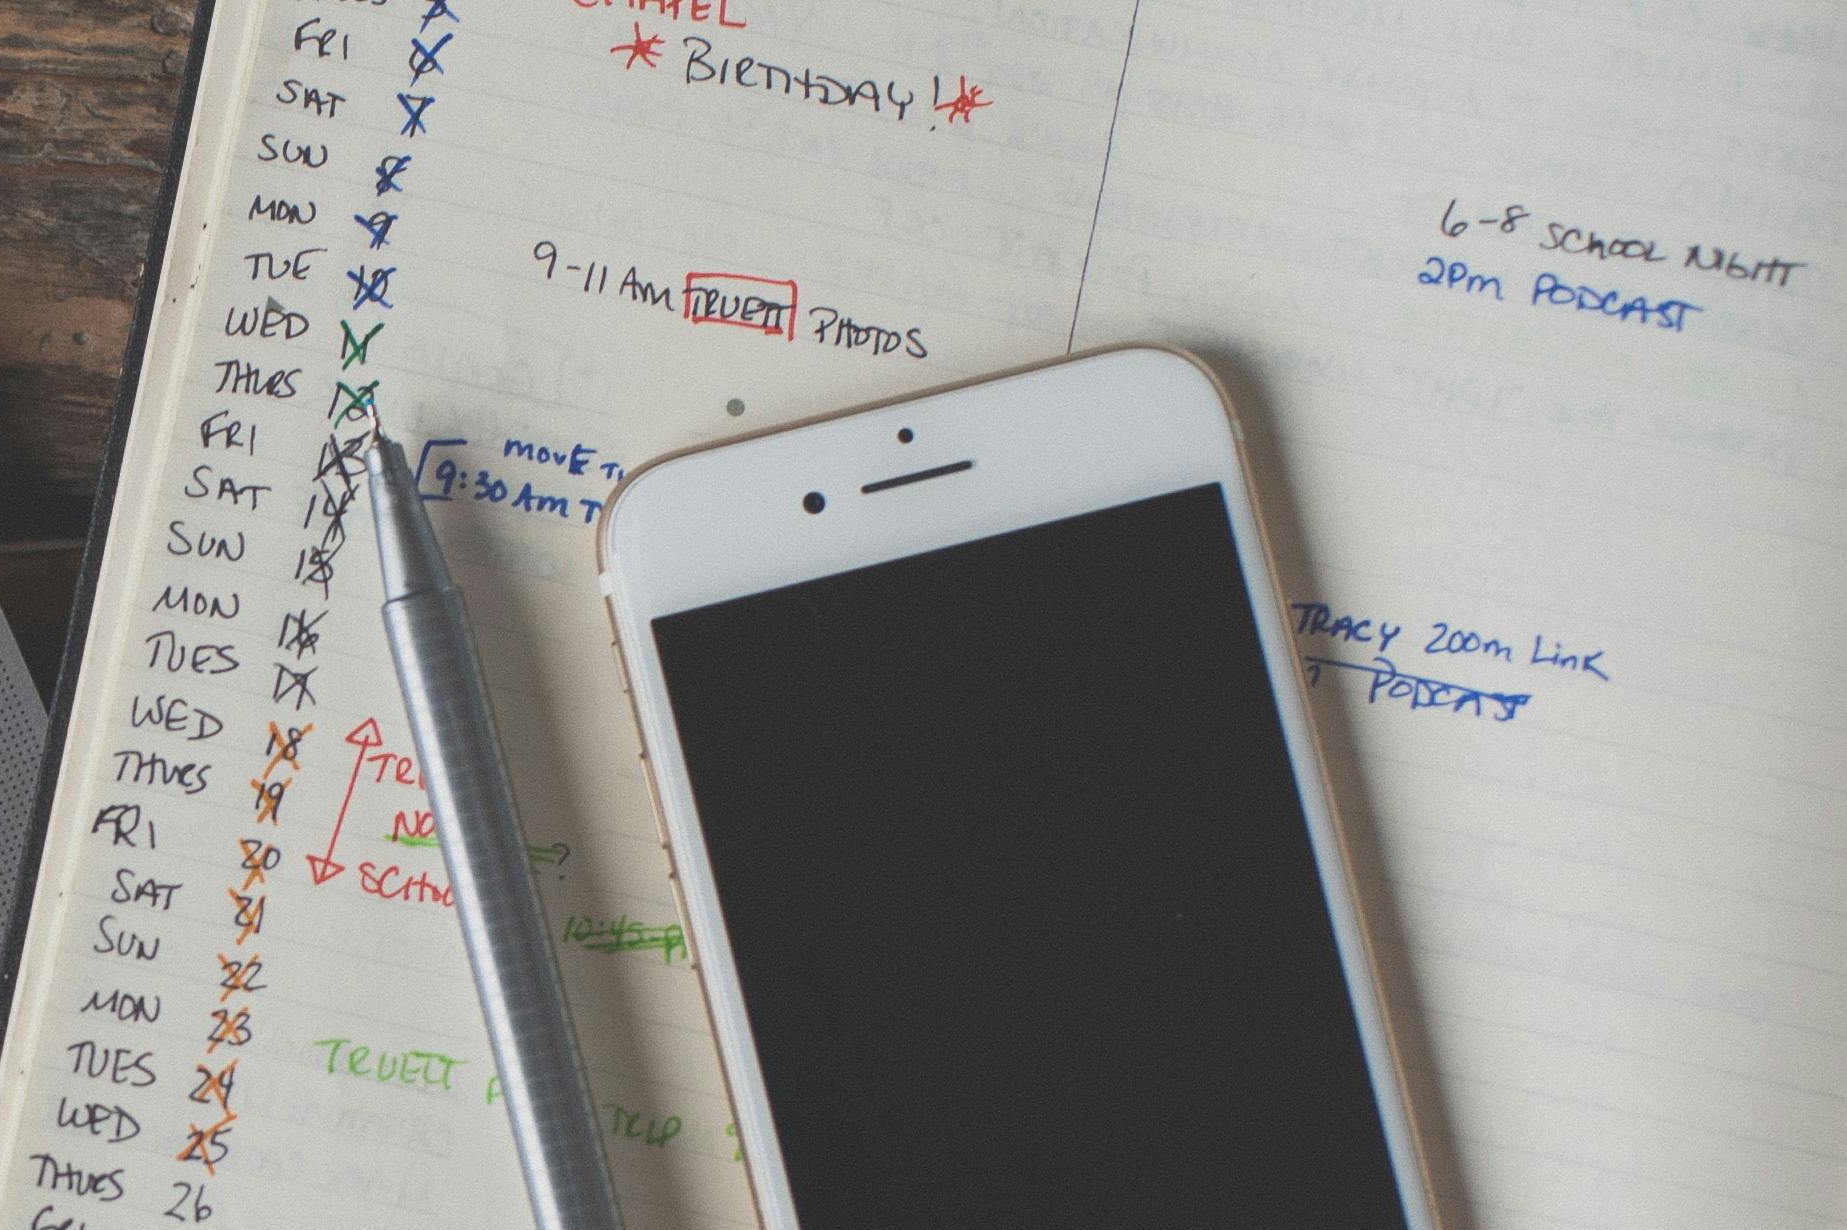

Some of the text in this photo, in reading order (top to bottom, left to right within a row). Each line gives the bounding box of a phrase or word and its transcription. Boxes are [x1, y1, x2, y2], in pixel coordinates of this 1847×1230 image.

[294, 17, 349, 60] FRI
[276, 79, 435, 137] SAT 7
[257, 134, 328, 169] SUN
[249, 194, 398, 250] MON 9
[1439, 198, 1531, 239] 6-8
[244, 248, 392, 304] TUE 10
[1531, 272, 1705, 333] PODCAST
[225, 305, 309, 340] WED
[809, 306, 928, 359] PHOTOS
[215, 359, 302, 398] THURS
[200, 410, 256, 456] FRI
[184, 465, 272, 511] SAT
[435, 459, 508, 503] 9:30
[167, 520, 245, 562] SUN
[152, 585, 240, 619] MON
[1289, 602, 1400, 652] TRACY
[145, 630, 240, 675] TUES
[131, 694, 308, 768] WED 18
[113, 751, 289, 825] THURS 19
[91, 804, 282, 879] FRI 20
[111, 868, 265, 939] SAT 21
[93, 914, 269, 996] SUN 22
[80, 989, 252, 1051] MON 23
[68, 1041, 236, 1108] TUES 24
[57, 1097, 235, 1171] WED 25
[30, 1153, 213, 1223] THURS 26
